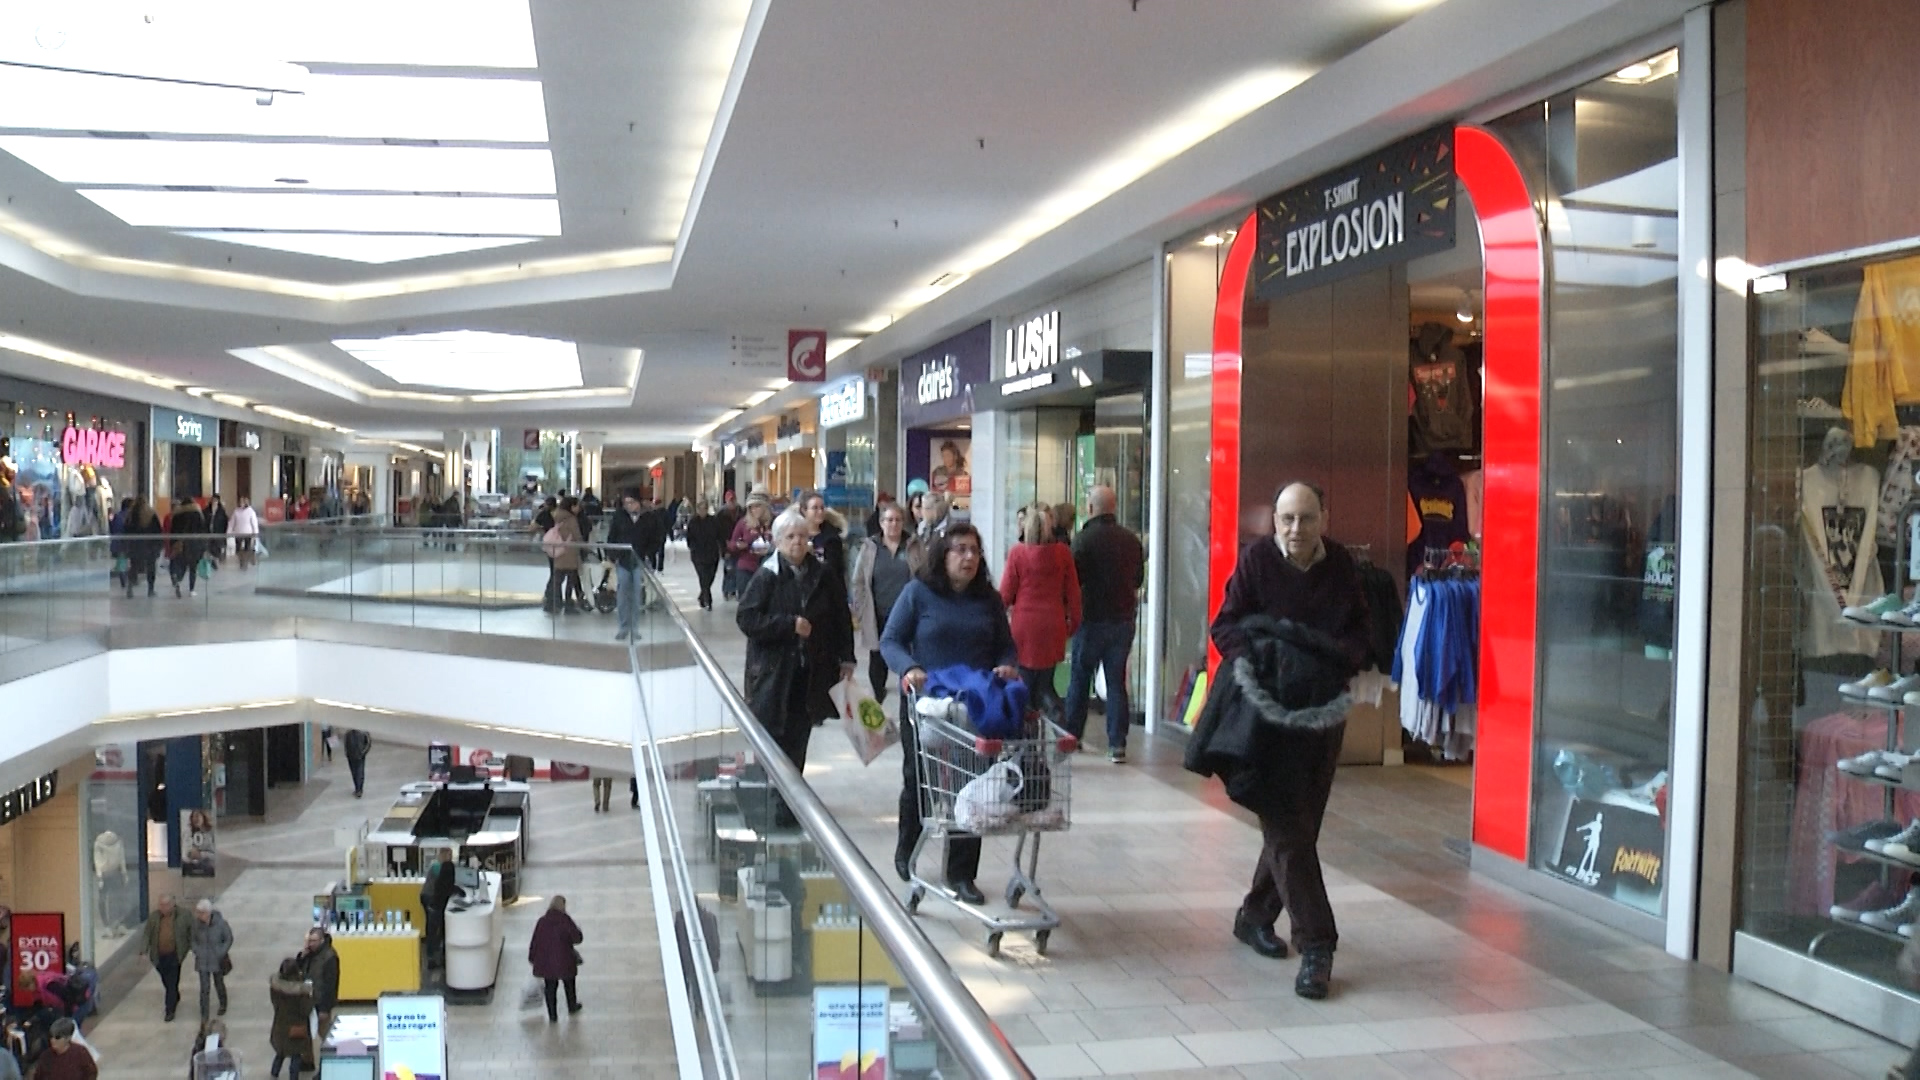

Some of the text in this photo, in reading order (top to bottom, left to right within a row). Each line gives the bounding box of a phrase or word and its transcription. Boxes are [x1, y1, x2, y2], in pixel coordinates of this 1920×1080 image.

[1323, 177, 1360, 211] T-SHIRT
[1286, 191, 1404, 277] EXPLOSION
[1005, 310, 1058, 378] LUSH
[918, 353, 952, 406] claire's
[177, 415, 203, 442] Spring
[63, 427, 126, 468] GARAGE
[1612, 845, 1660, 886] FORTNITE
[18, 936, 59, 948] EXTRA
[386, 1013, 402, 1021] Say
[408, 1022, 436, 1030] regret
